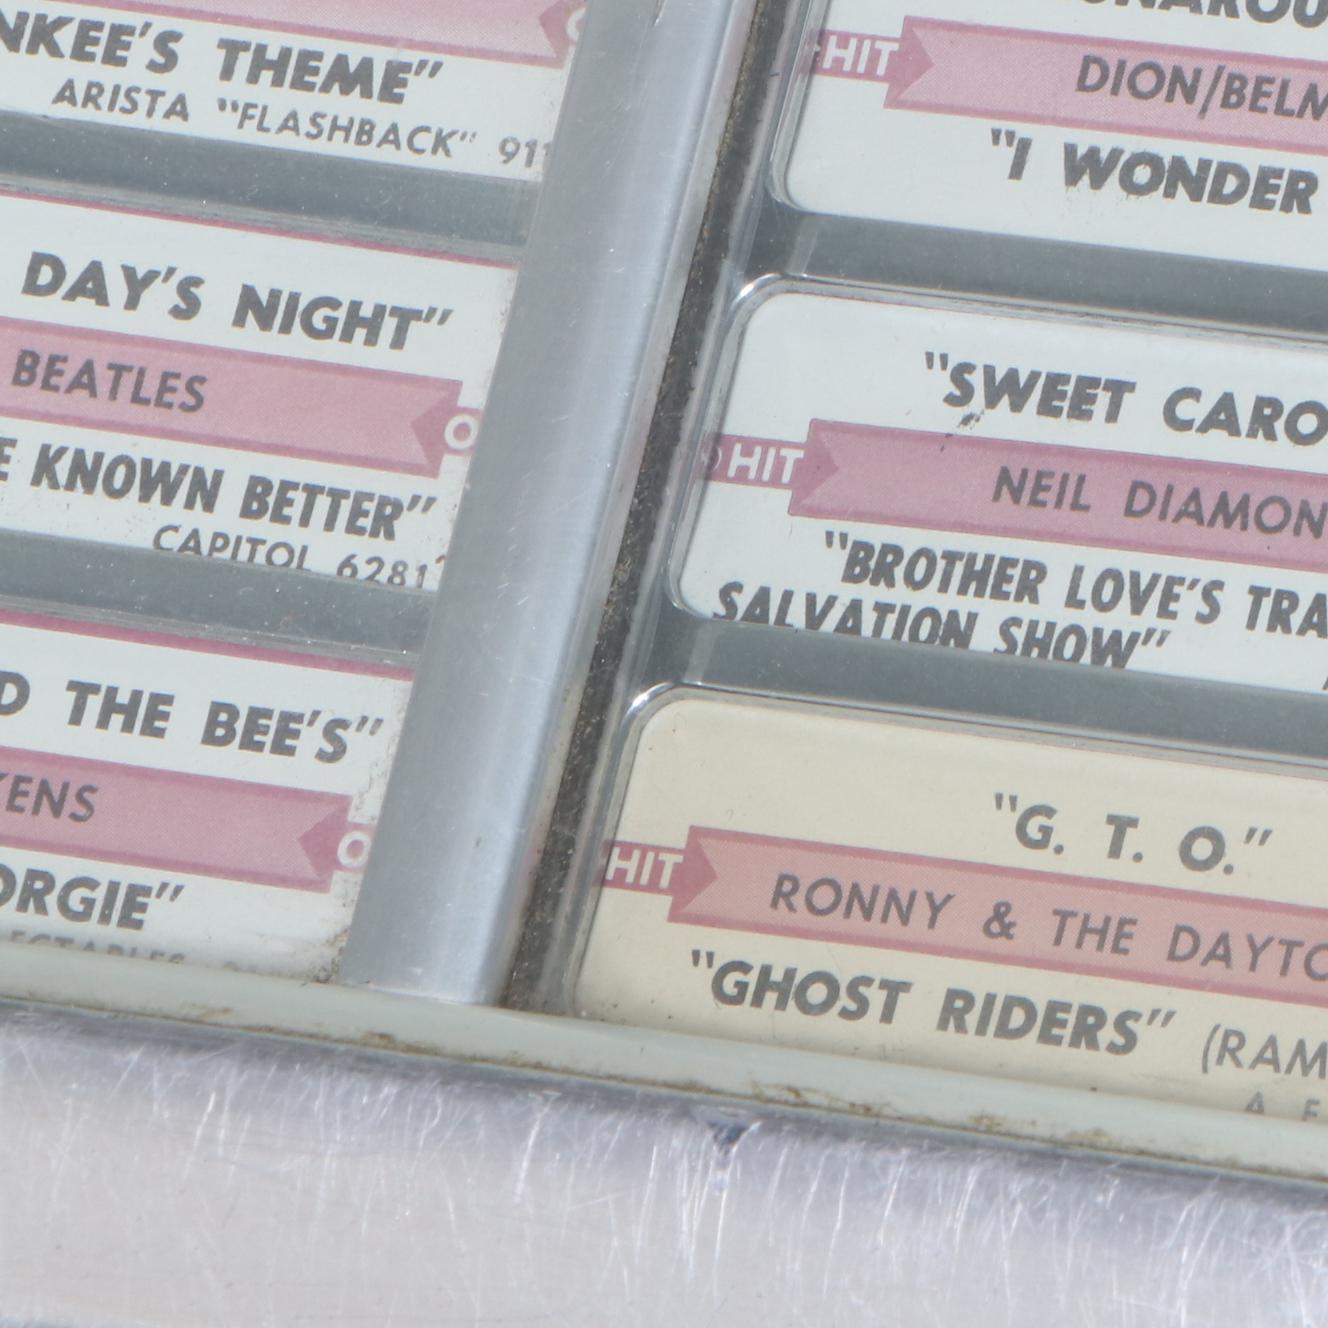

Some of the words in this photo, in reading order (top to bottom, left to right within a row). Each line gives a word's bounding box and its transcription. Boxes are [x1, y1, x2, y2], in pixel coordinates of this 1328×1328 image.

[51, 77, 190, 123] ARISTA
[217, 97, 477, 158] "FLASHBACK"
[990, 126, 1033, 181] "I
[1063, 141, 1320, 215] WONDER
[21, 250, 206, 321] DAY'S
[231, 283, 454, 351] NIGHT"
[11, 348, 209, 413] BEATLES
[924, 350, 1138, 424] "SWEET
[991, 465, 1091, 513] NEIL
[824, 529, 1048, 606] "BROTHER
[1063, 563, 1226, 625] LOVE'S
[994, 791, 1063, 854] "G.
[1105, 812, 1143, 862] T.
[1178, 825, 1272, 876] O."
[769, 872, 956, 930] RONNY
[982, 900, 1017, 941] &
[1052, 908, 1139, 956] THE
[690, 948, 914, 1025] "GHOST
[936, 987, 1177, 1056] RIDERS"
